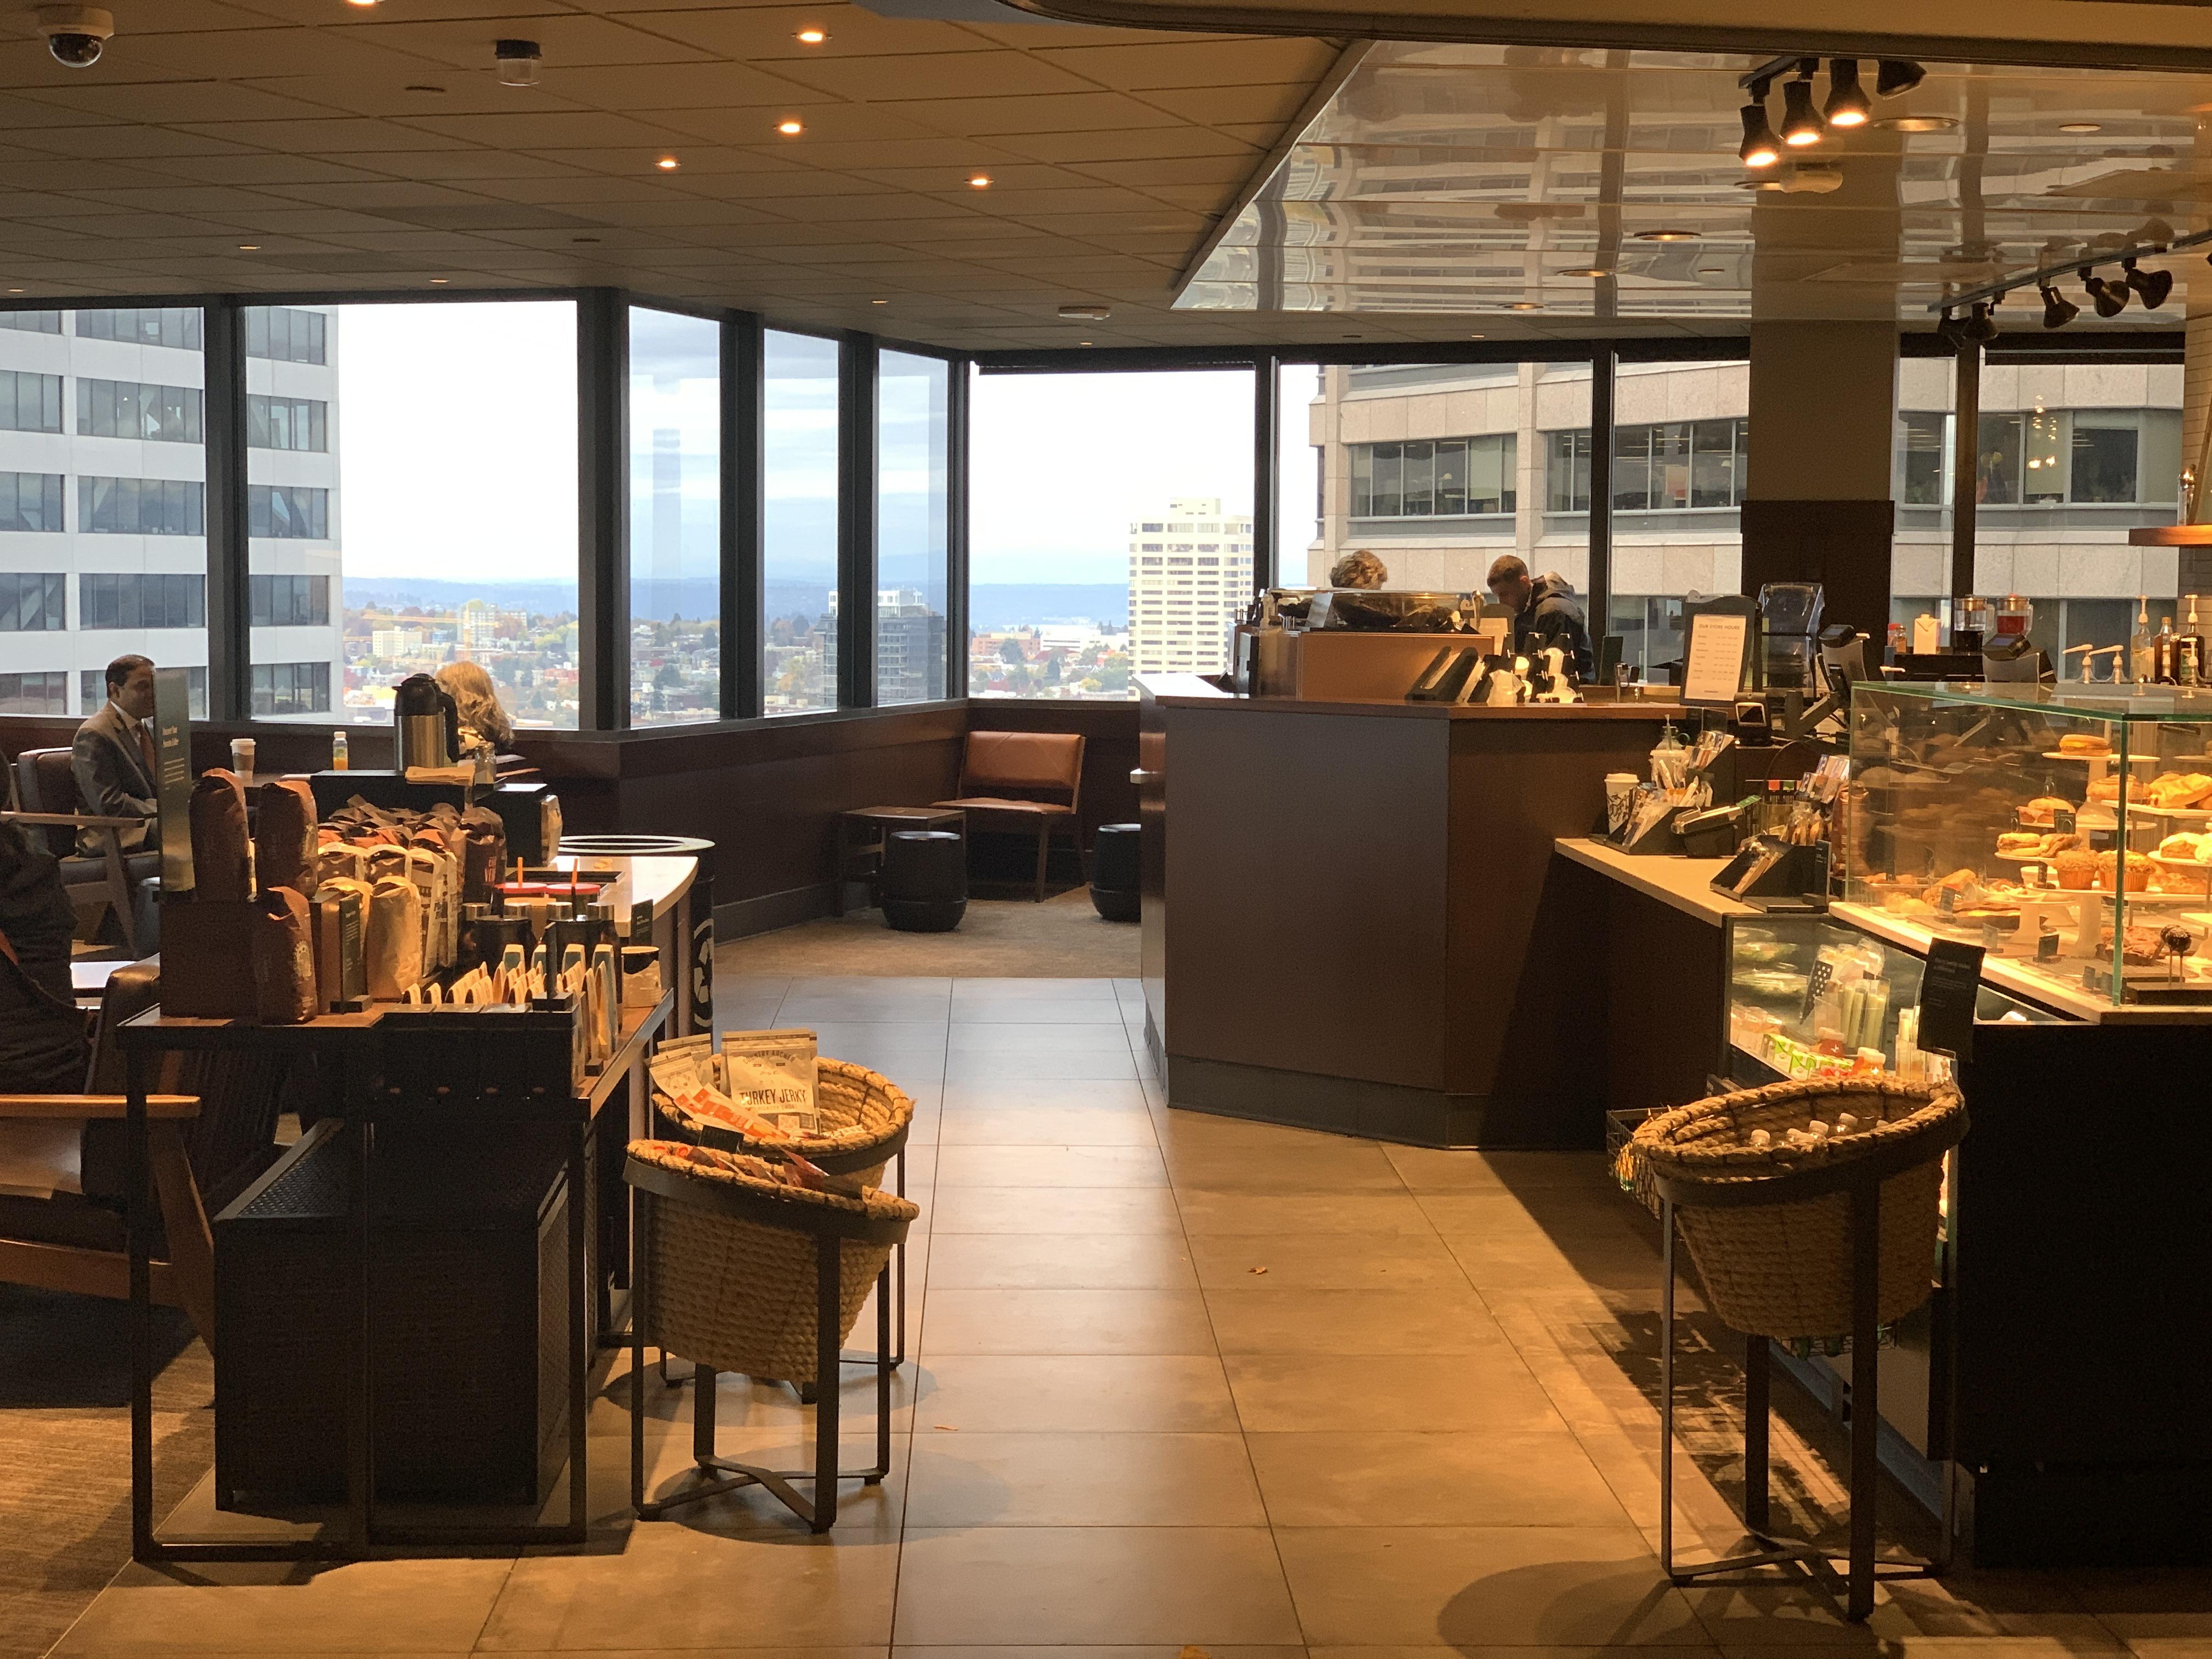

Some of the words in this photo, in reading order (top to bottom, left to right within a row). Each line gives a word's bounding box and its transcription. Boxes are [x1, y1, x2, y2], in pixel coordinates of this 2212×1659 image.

[742, 1050, 769, 1064] COUNTRY
[771, 1050, 795, 1063] ARCHER
[739, 1088, 776, 1105] TURKEY
[780, 1088, 805, 1103] JERKY
